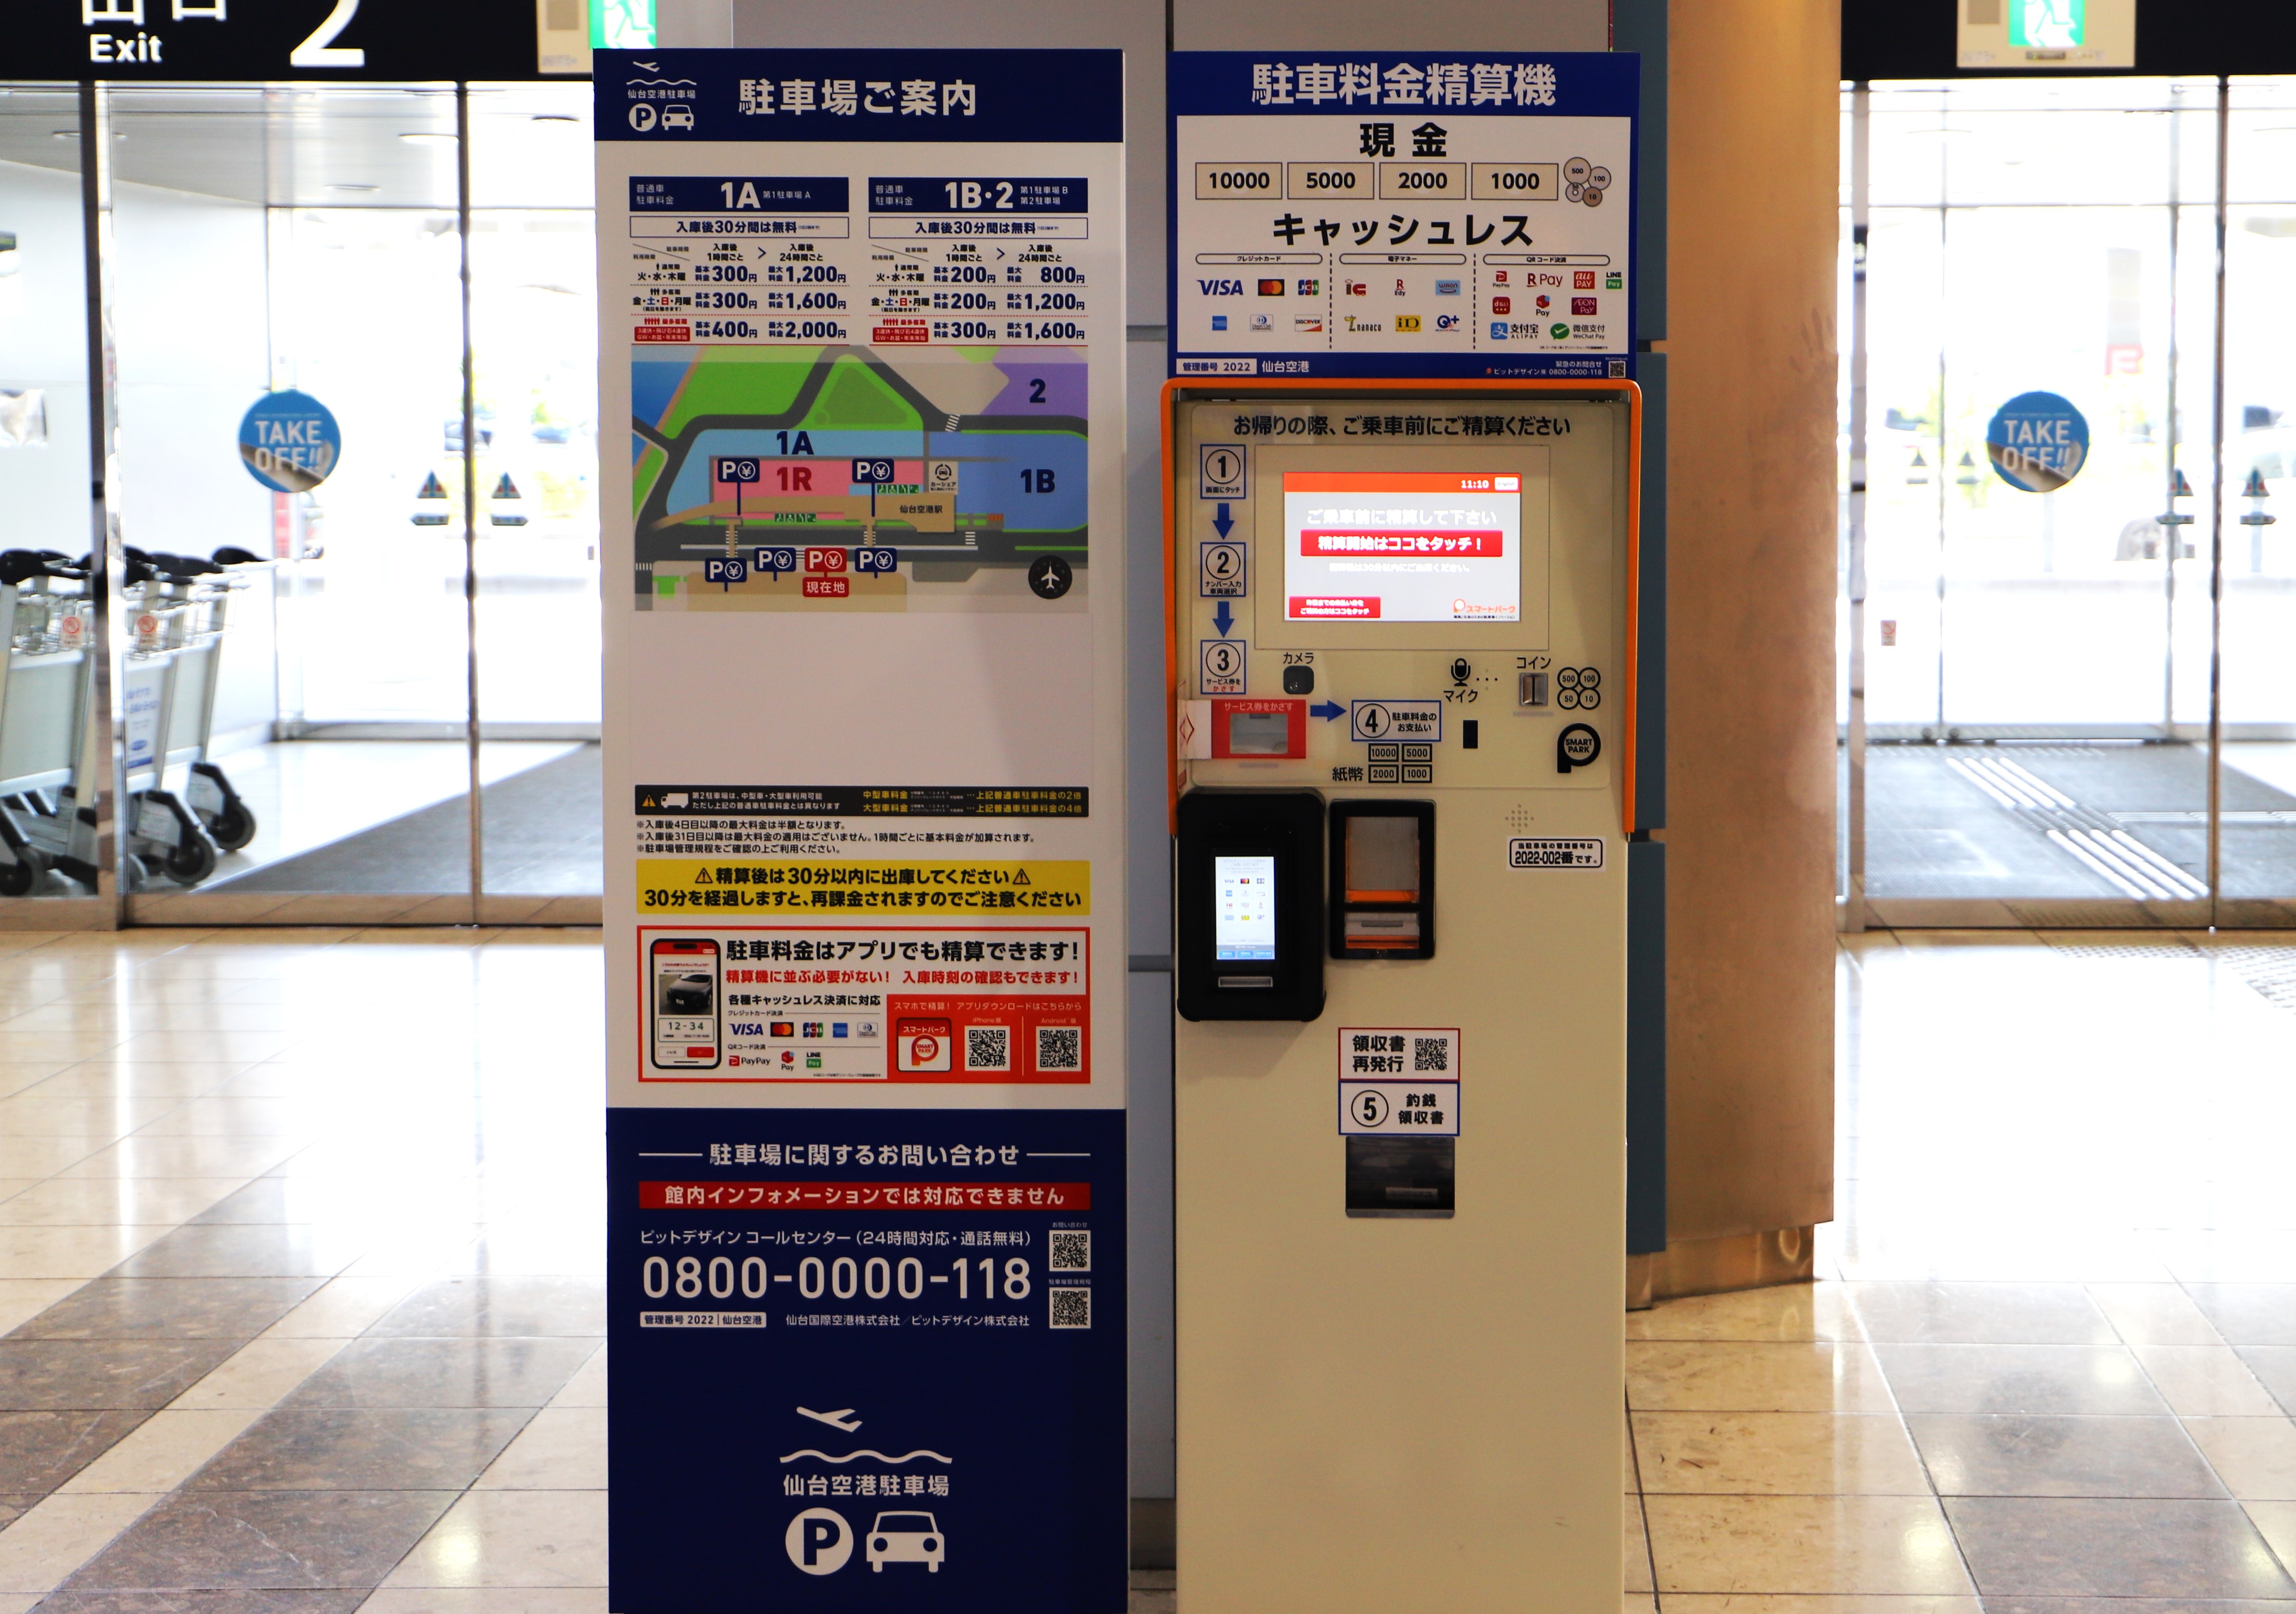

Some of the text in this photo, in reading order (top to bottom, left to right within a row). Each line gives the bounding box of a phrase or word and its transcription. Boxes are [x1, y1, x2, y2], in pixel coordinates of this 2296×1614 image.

[290, 0, 364, 67] 2
[90, 32, 163, 63] Exit
[1252, 63, 1556, 106] 駐車料金精算機
[628, 89, 696, 99] 仙台空港駐車場
[738, 79, 977, 115] 駐車場ご案内
[1360, 122, 1447, 158] 現金
[636, 184, 664, 193] 普通車
[1209, 173, 1269, 190] 10000
[1306, 173, 1355, 190] 5000
[1398, 173, 1448, 190] 2000
[1492, 173, 1539, 190] 1000
[636, 196, 674, 204] 駐車料金
[721, 182, 761, 208] 1A
[1020, 197, 1060, 205] 第2駐車場
[677, 220, 797, 233] 入庫後30分間は無料
[915, 221, 1036, 234] 入庫後30分間は無料
[1273, 213, 1533, 246] キャッシュレス
[707, 253, 744, 261] 1時間ごと
[780, 253, 823, 262] 24時間ごと
[713, 266, 757, 282] 300円
[786, 266, 846, 283] 1,200円
[951, 266, 995, 283] 200円
[1041, 266, 1085, 283] 800円
[1540, 274, 1563, 287] Pay
[1576, 272, 1593, 280] au
[1196, 279, 1243, 295] VISA
[1298, 279, 1319, 295] JCB
[713, 292, 757, 309] 300円
[786, 292, 846, 310] 1,600円
[951, 293, 995, 310] 200円
[1025, 293, 1085, 312] 1,200円
[1536, 309, 1550, 317] Pay
[712, 321, 757, 338] 400円
[785, 321, 846, 339] 2,000円
[951, 322, 995, 339] 300円
[1025, 322, 1085, 340] 1,600円
[1357, 323, 1381, 331] nanaco
[1511, 324, 1539, 333] 支付宝
[1573, 324, 1605, 332] 微信支付
[1183, 361, 1309, 373] 管理番号 2022 仙台空港
[1029, 378, 1046, 403] 2
[255, 421, 321, 444] TAKE
[1234, 415, 1571, 436] お帰りの際、ご乗車前にご精算ください
[2004, 420, 2070, 444] TAKE
[777, 431, 814, 455] 1A
[777, 467, 812, 490] 1R
[1020, 469, 1055, 493] 1B
[1461, 480, 1489, 488] 11:10
[900, 504, 943, 514] 仙台空港駅
[807, 581, 845, 594] 現在地
[1283, 652, 1313, 664] カメラ
[1517, 656, 1551, 669] コイン
[1443, 689, 1478, 703] マイク
[1224, 702, 1293, 710] サービス券をかざす
[1392, 712, 1437, 721] 駐車料金の
[1397, 724, 1431, 732] お支払い
[1371, 748, 1396, 757] 10000
[1407, 748, 1427, 757] 5000
[1332, 767, 1363, 782] 紙幣
[1373, 770, 1394, 778] 2000
[1407, 770, 1426, 778] 1000
[863, 790, 908, 799] 中型車料金
[863, 803, 908, 813] 大型車料金
[637, 820, 845, 830] ※入庫後4日目以降の最大料金は半額となります。
[716, 867, 1009, 885] 精算後は30分以内に出庫してください
[645, 890, 1081, 908] 30分を経過しますと、再課金されますのでご注意ください
[729, 994, 881, 1006] 各種キャッシュレス決済に対応
[957, 1002, 1081, 1010] アプリダウンロードはこちらから
[729, 1023, 763, 1035] VISA
[1353, 1035, 1405, 1052] 領収書
[742, 1057, 770, 1066] PayPay
[1353, 1056, 1404, 1072] 再発行
[1406, 1094, 1436, 1107] 釣銭
[1398, 1111, 1444, 1124] 領収書
[710, 1143, 1019, 1166] 駐車場に関するお問い合わせ
[665, 1186, 1064, 1205] 館内インフォメーションでは対応できません
[641, 1229, 741, 1245] ピットデザイン
[747, 1231, 851, 1245] コールセンター
[643, 1256, 1030, 1299] 0800-0000-118
[644, 1315, 762, 1325] 管理番号 2022 仙台空港
[783, 1475, 949, 1496] 仙台空港駐車場
